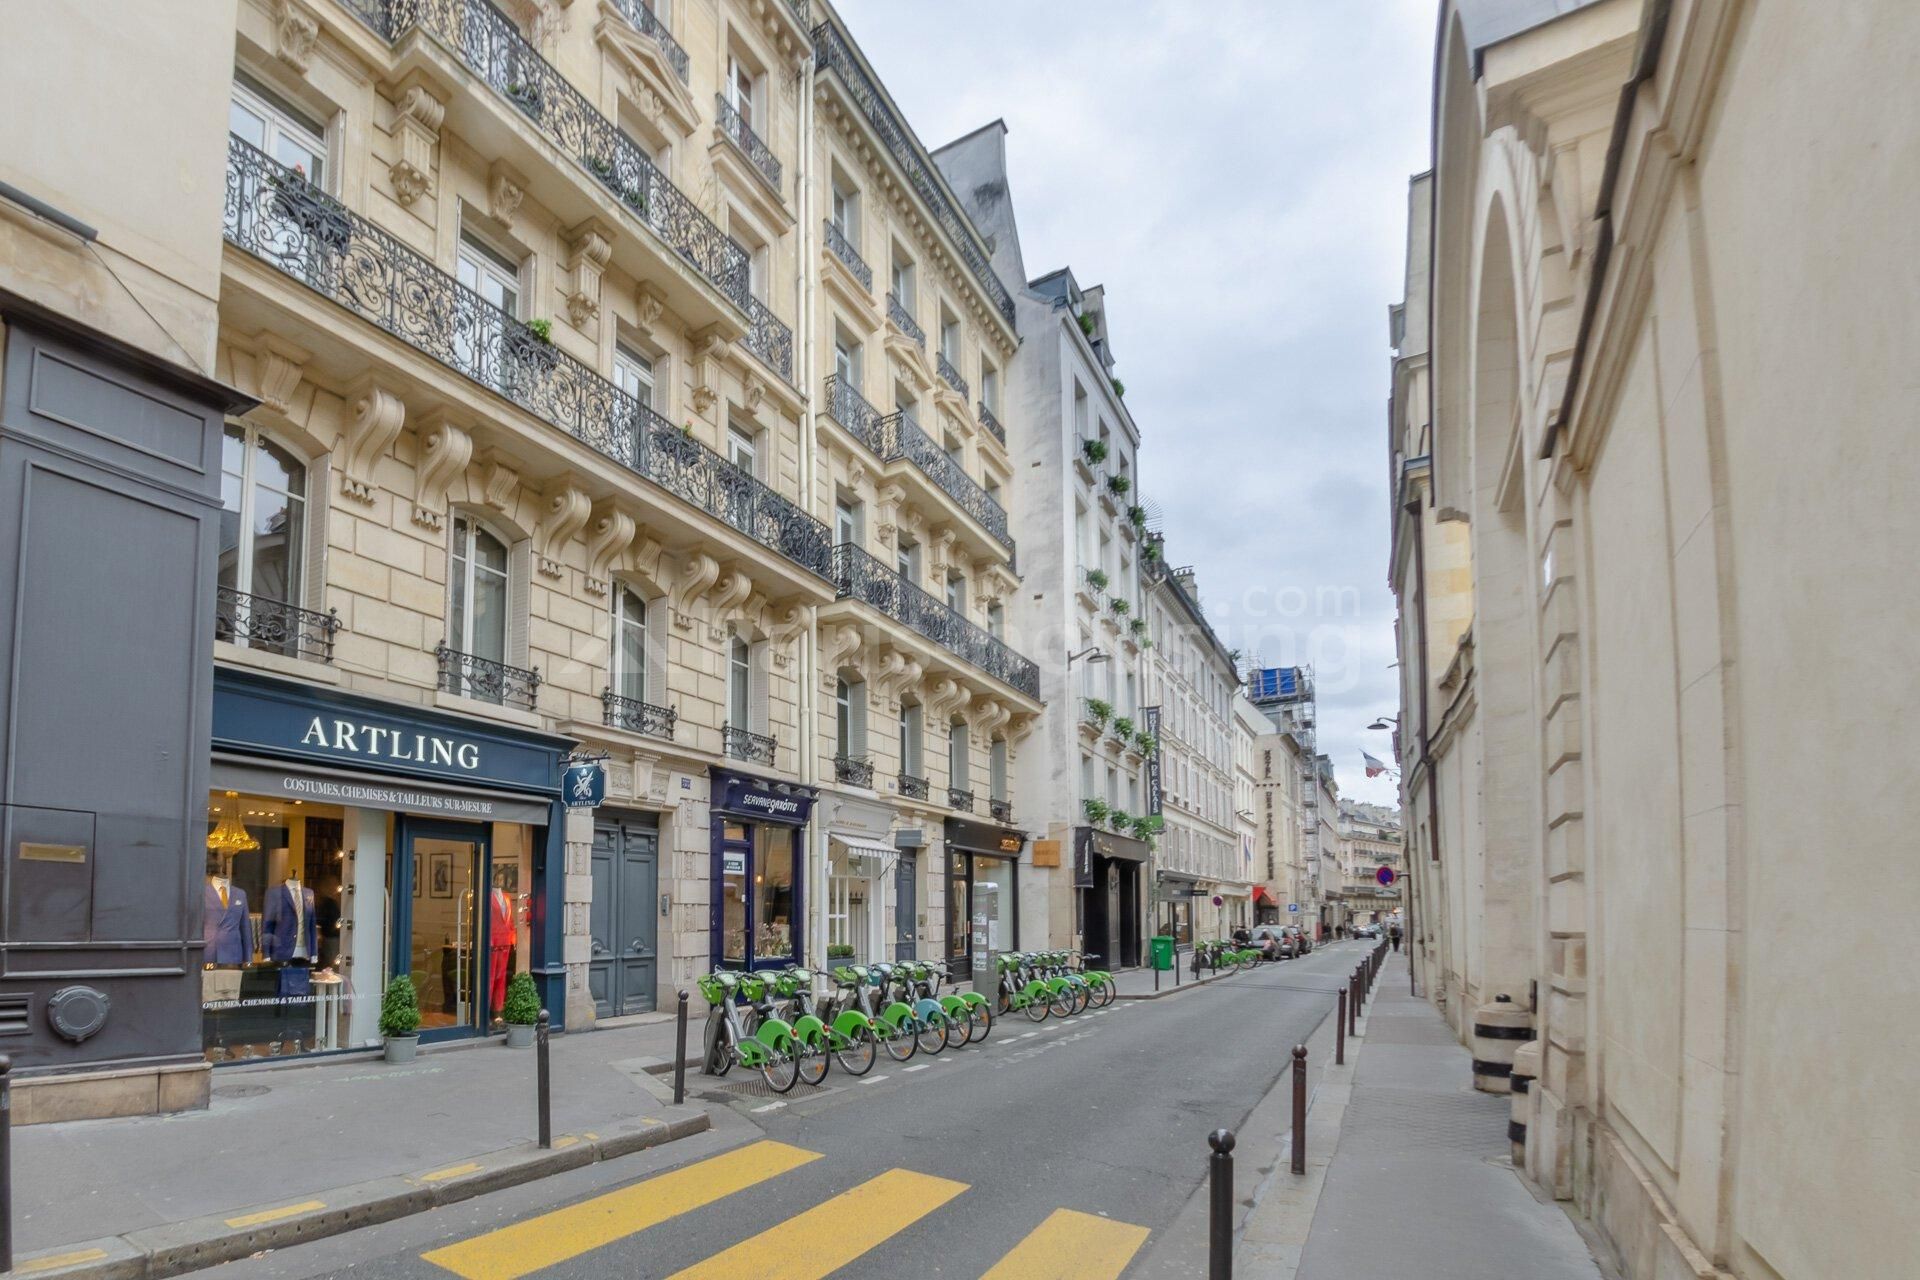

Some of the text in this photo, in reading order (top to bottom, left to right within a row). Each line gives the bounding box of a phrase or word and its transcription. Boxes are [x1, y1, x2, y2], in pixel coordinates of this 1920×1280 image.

[301, 716, 479, 769] ARTLING
[283, 777, 492, 814] COSTUMES, CHEMISES & TAILLEURS SUR-MESURE
[242, 997, 279, 1007] CHEMISES
